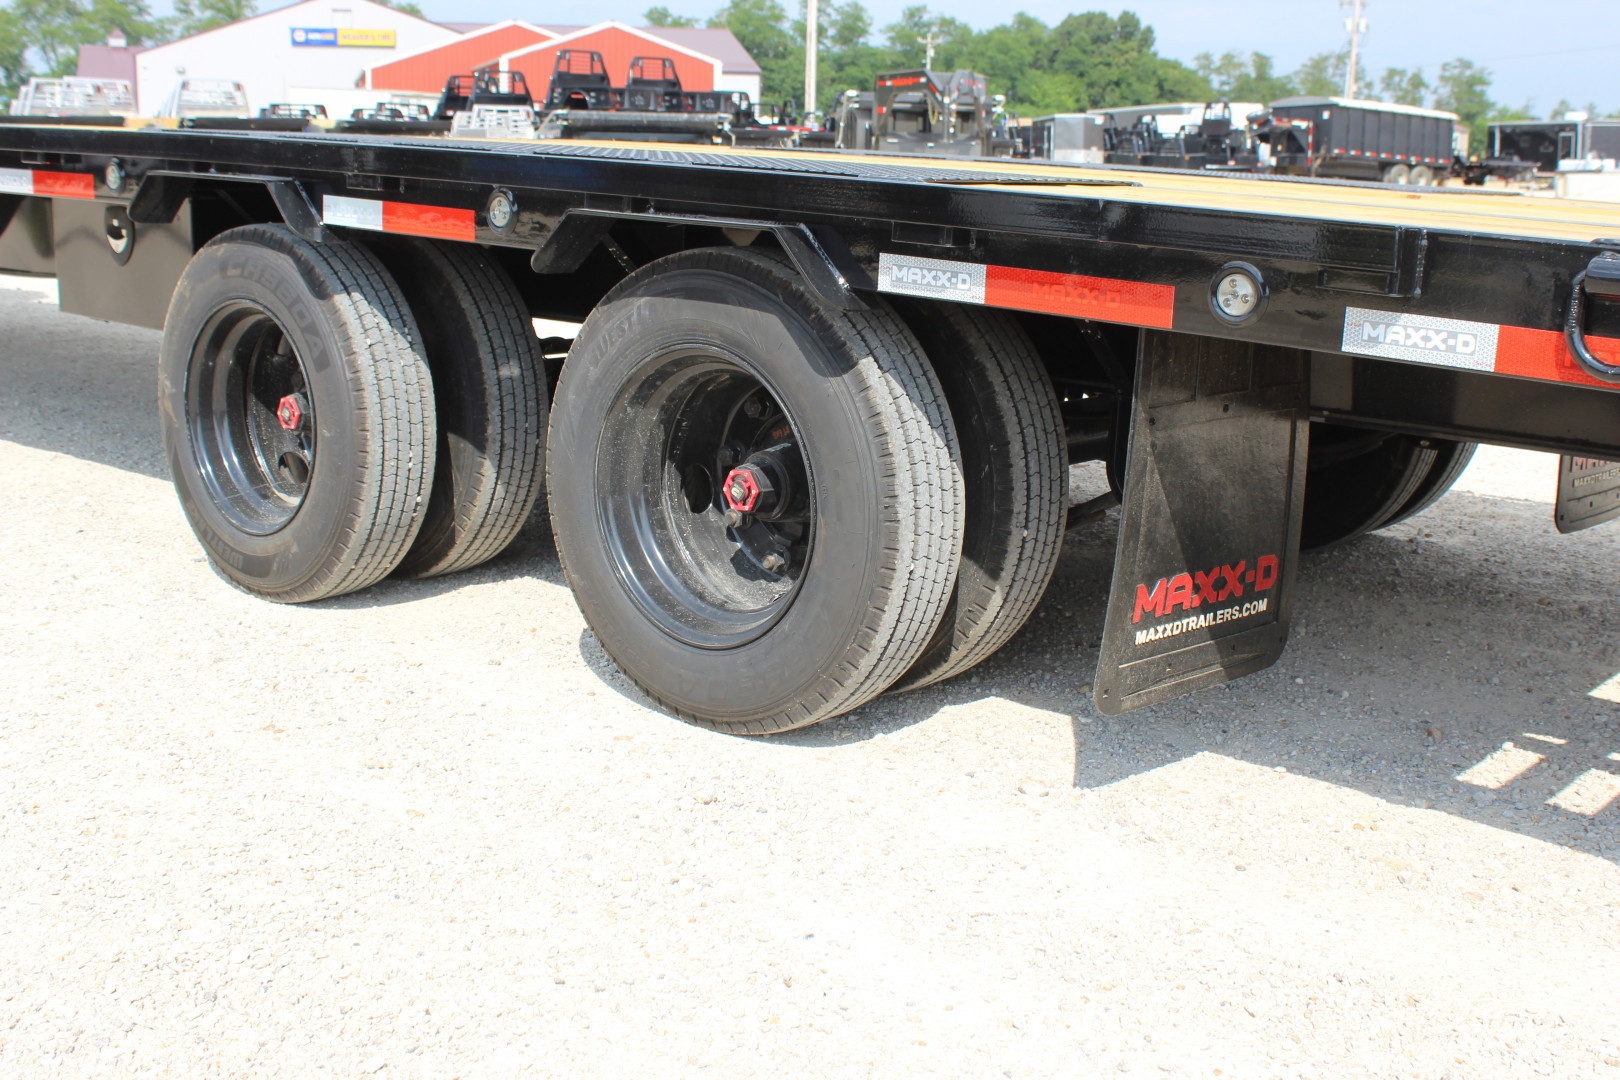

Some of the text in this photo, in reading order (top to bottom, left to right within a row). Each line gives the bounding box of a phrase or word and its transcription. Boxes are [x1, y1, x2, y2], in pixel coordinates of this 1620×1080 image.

[891, 265, 971, 290] MAXX-D
[1032, 281, 1121, 308] MAXX-D
[1362, 322, 1476, 354] MAXX-D
[1132, 554, 1279, 623] MAXX-D
[1135, 598, 1268, 645] MAXXDTRAILERS.COM
